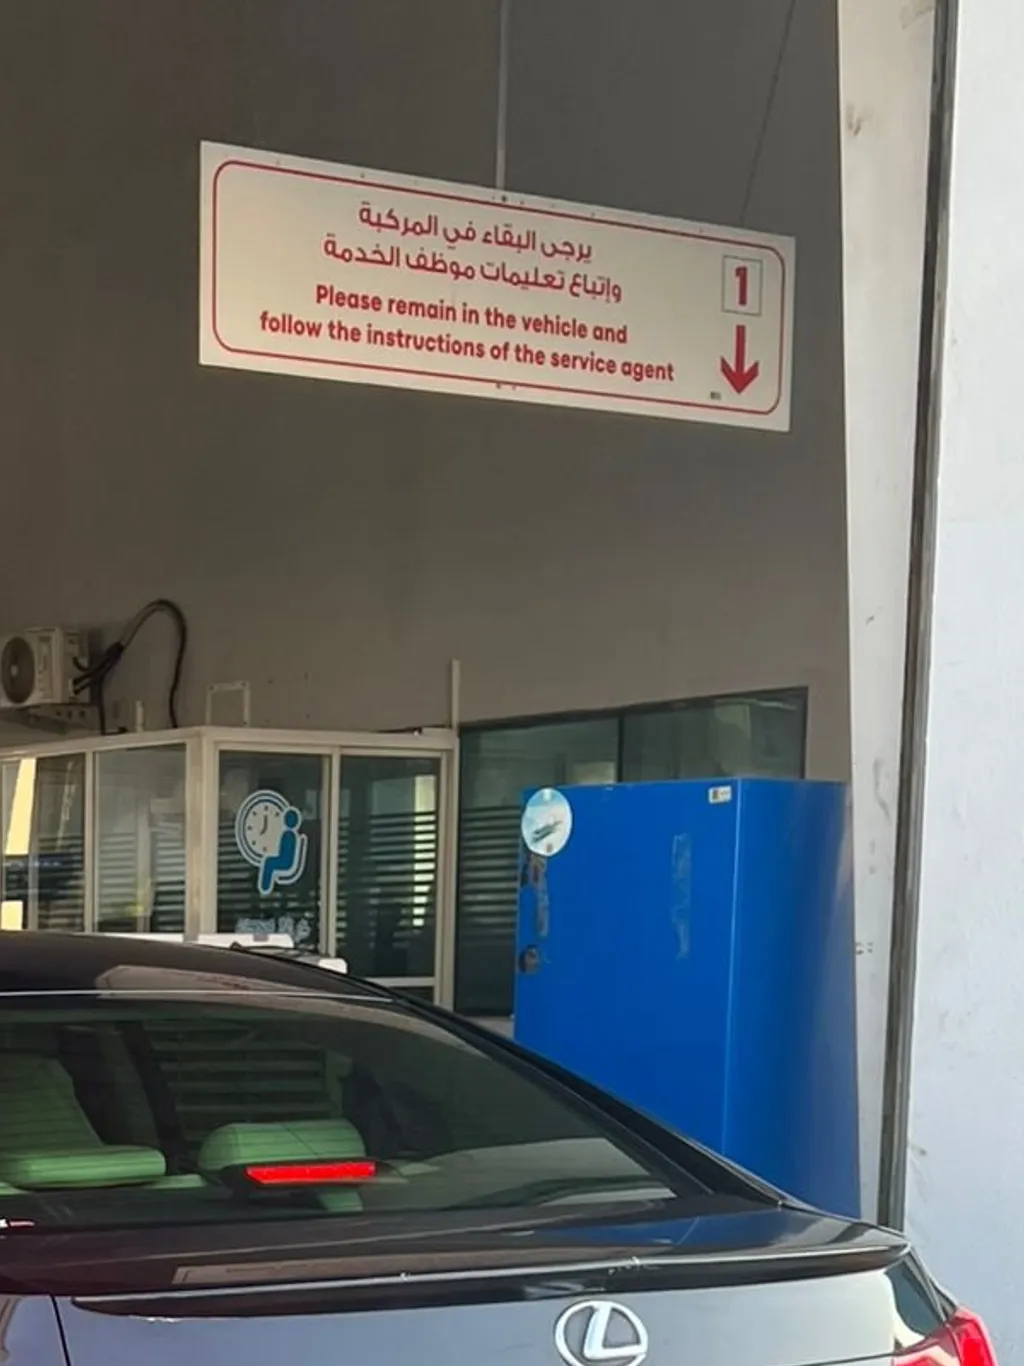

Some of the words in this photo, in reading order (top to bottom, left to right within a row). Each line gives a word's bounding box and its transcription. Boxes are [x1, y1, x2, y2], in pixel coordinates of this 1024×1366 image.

[358, 201, 439, 237] المركبة
[443, 221, 477, 251] في
[323, 232, 401, 268] الخدمة
[482, 224, 537, 254] البقاء
[540, 240, 592, 265] يرجى
[404, 246, 476, 281] موظف
[479, 261, 566, 291] تعليمات
[569, 272, 622, 304] وإتباع
[734, 266, 749, 307] 1
[315, 283, 383, 312] Please
[387, 297, 458, 323] remain
[462, 301, 480, 325] in
[484, 305, 518, 330] the
[522, 313, 589, 340] vehicle
[592, 323, 628, 344] and
[260, 309, 323, 339] follow
[327, 320, 363, 343] the
[366, 322, 486, 359] instructions
[490, 340, 511, 362] of
[514, 343, 546, 366] the
[549, 350, 618, 375] service
[621, 360, 675, 382] agent
